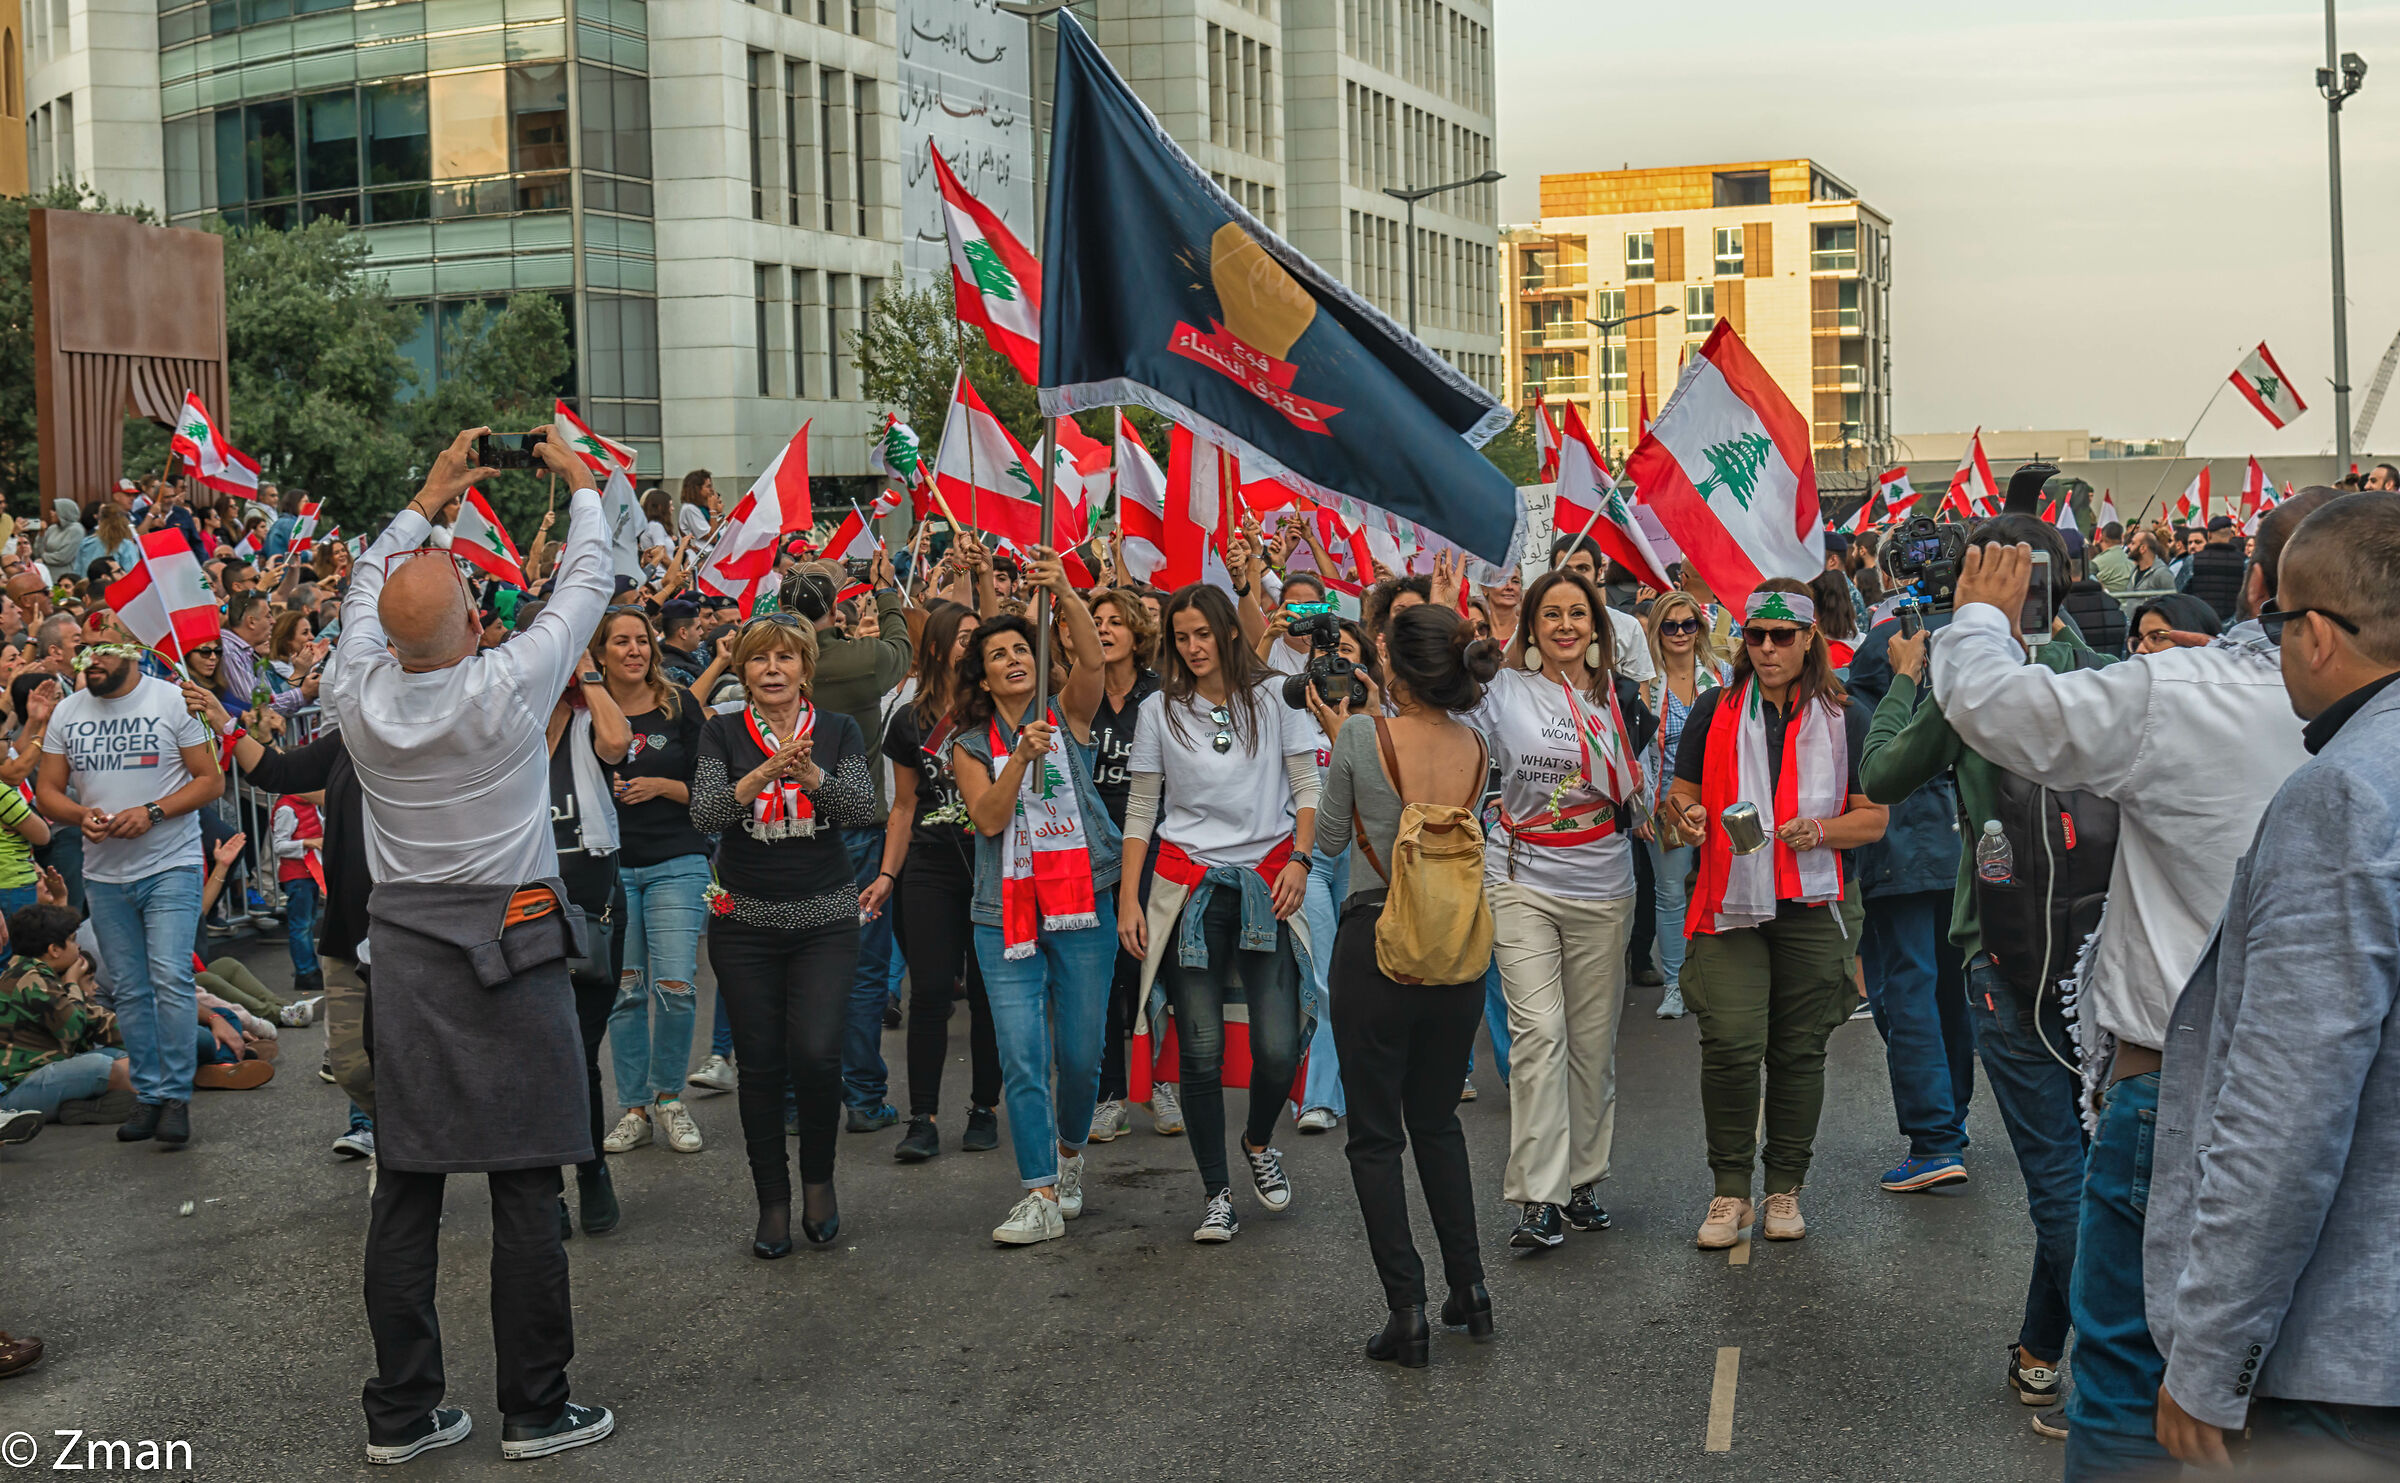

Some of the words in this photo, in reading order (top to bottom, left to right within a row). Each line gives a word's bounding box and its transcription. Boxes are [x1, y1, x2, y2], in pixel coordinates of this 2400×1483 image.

[1180, 332, 1247, 380] النساء
[1232, 341, 1271, 373] فوج
[1249, 377, 1319, 422] حقوق
[65, 717, 160, 738] TOMMY
[1551, 717, 1555, 725] I
[1557, 717, 1576, 729] AM
[64, 734, 160, 755] HILFIGER
[1541, 728, 1580, 743] WOM
[1521, 754, 1573, 770] WHAT'S
[1034, 816, 1076, 838] لبنان
